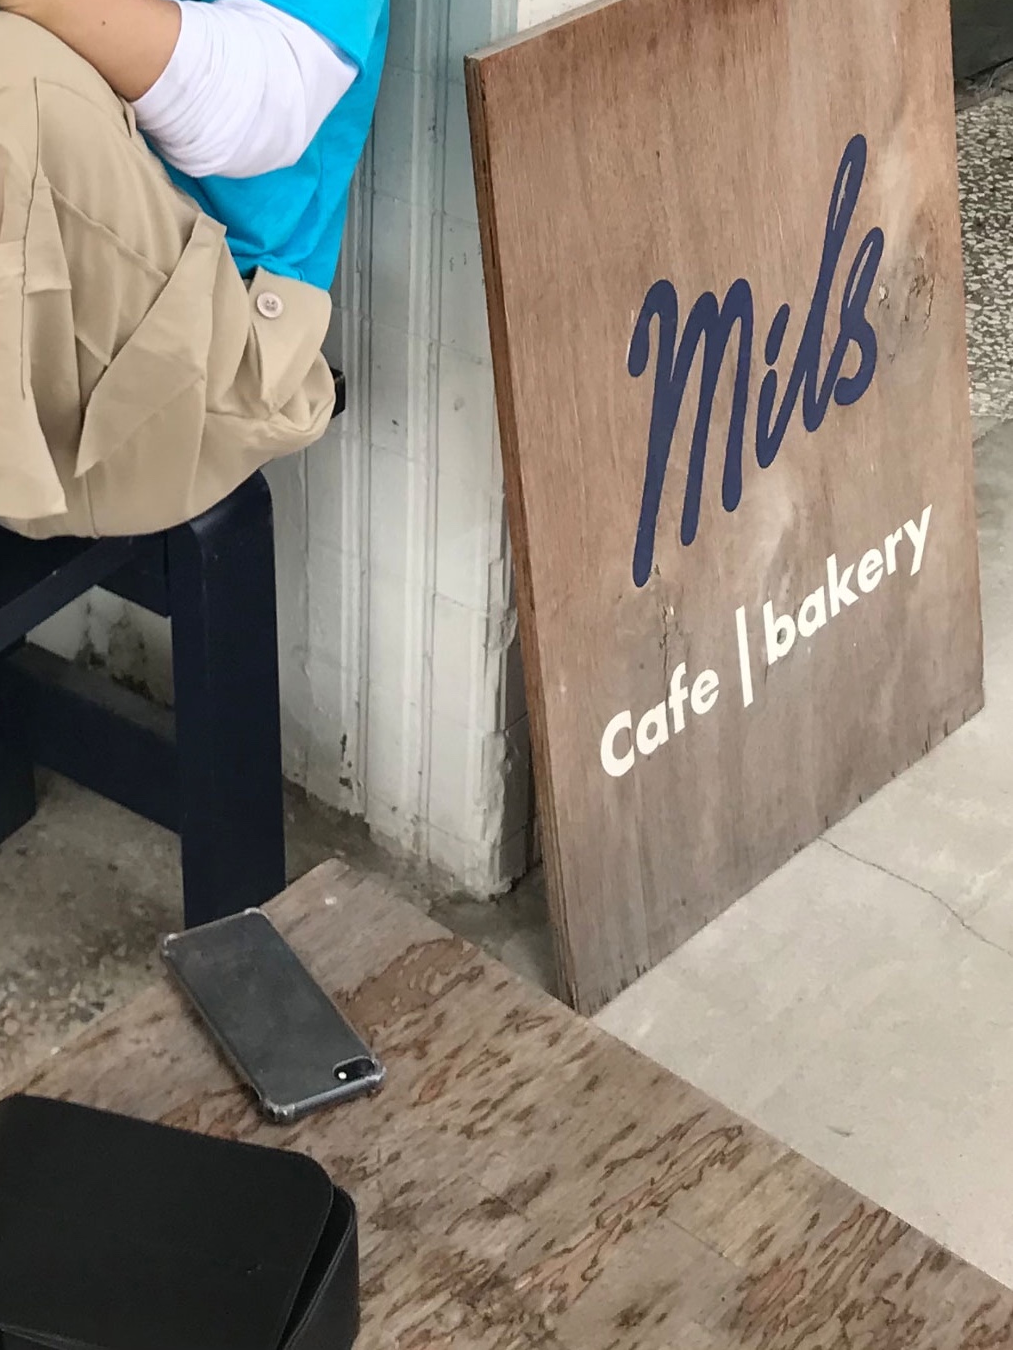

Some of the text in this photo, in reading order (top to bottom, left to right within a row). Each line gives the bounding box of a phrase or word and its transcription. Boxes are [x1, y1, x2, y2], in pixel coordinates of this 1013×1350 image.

[628, 135, 884, 587] Mils
[600, 504, 933, 777] Cafe bakery
